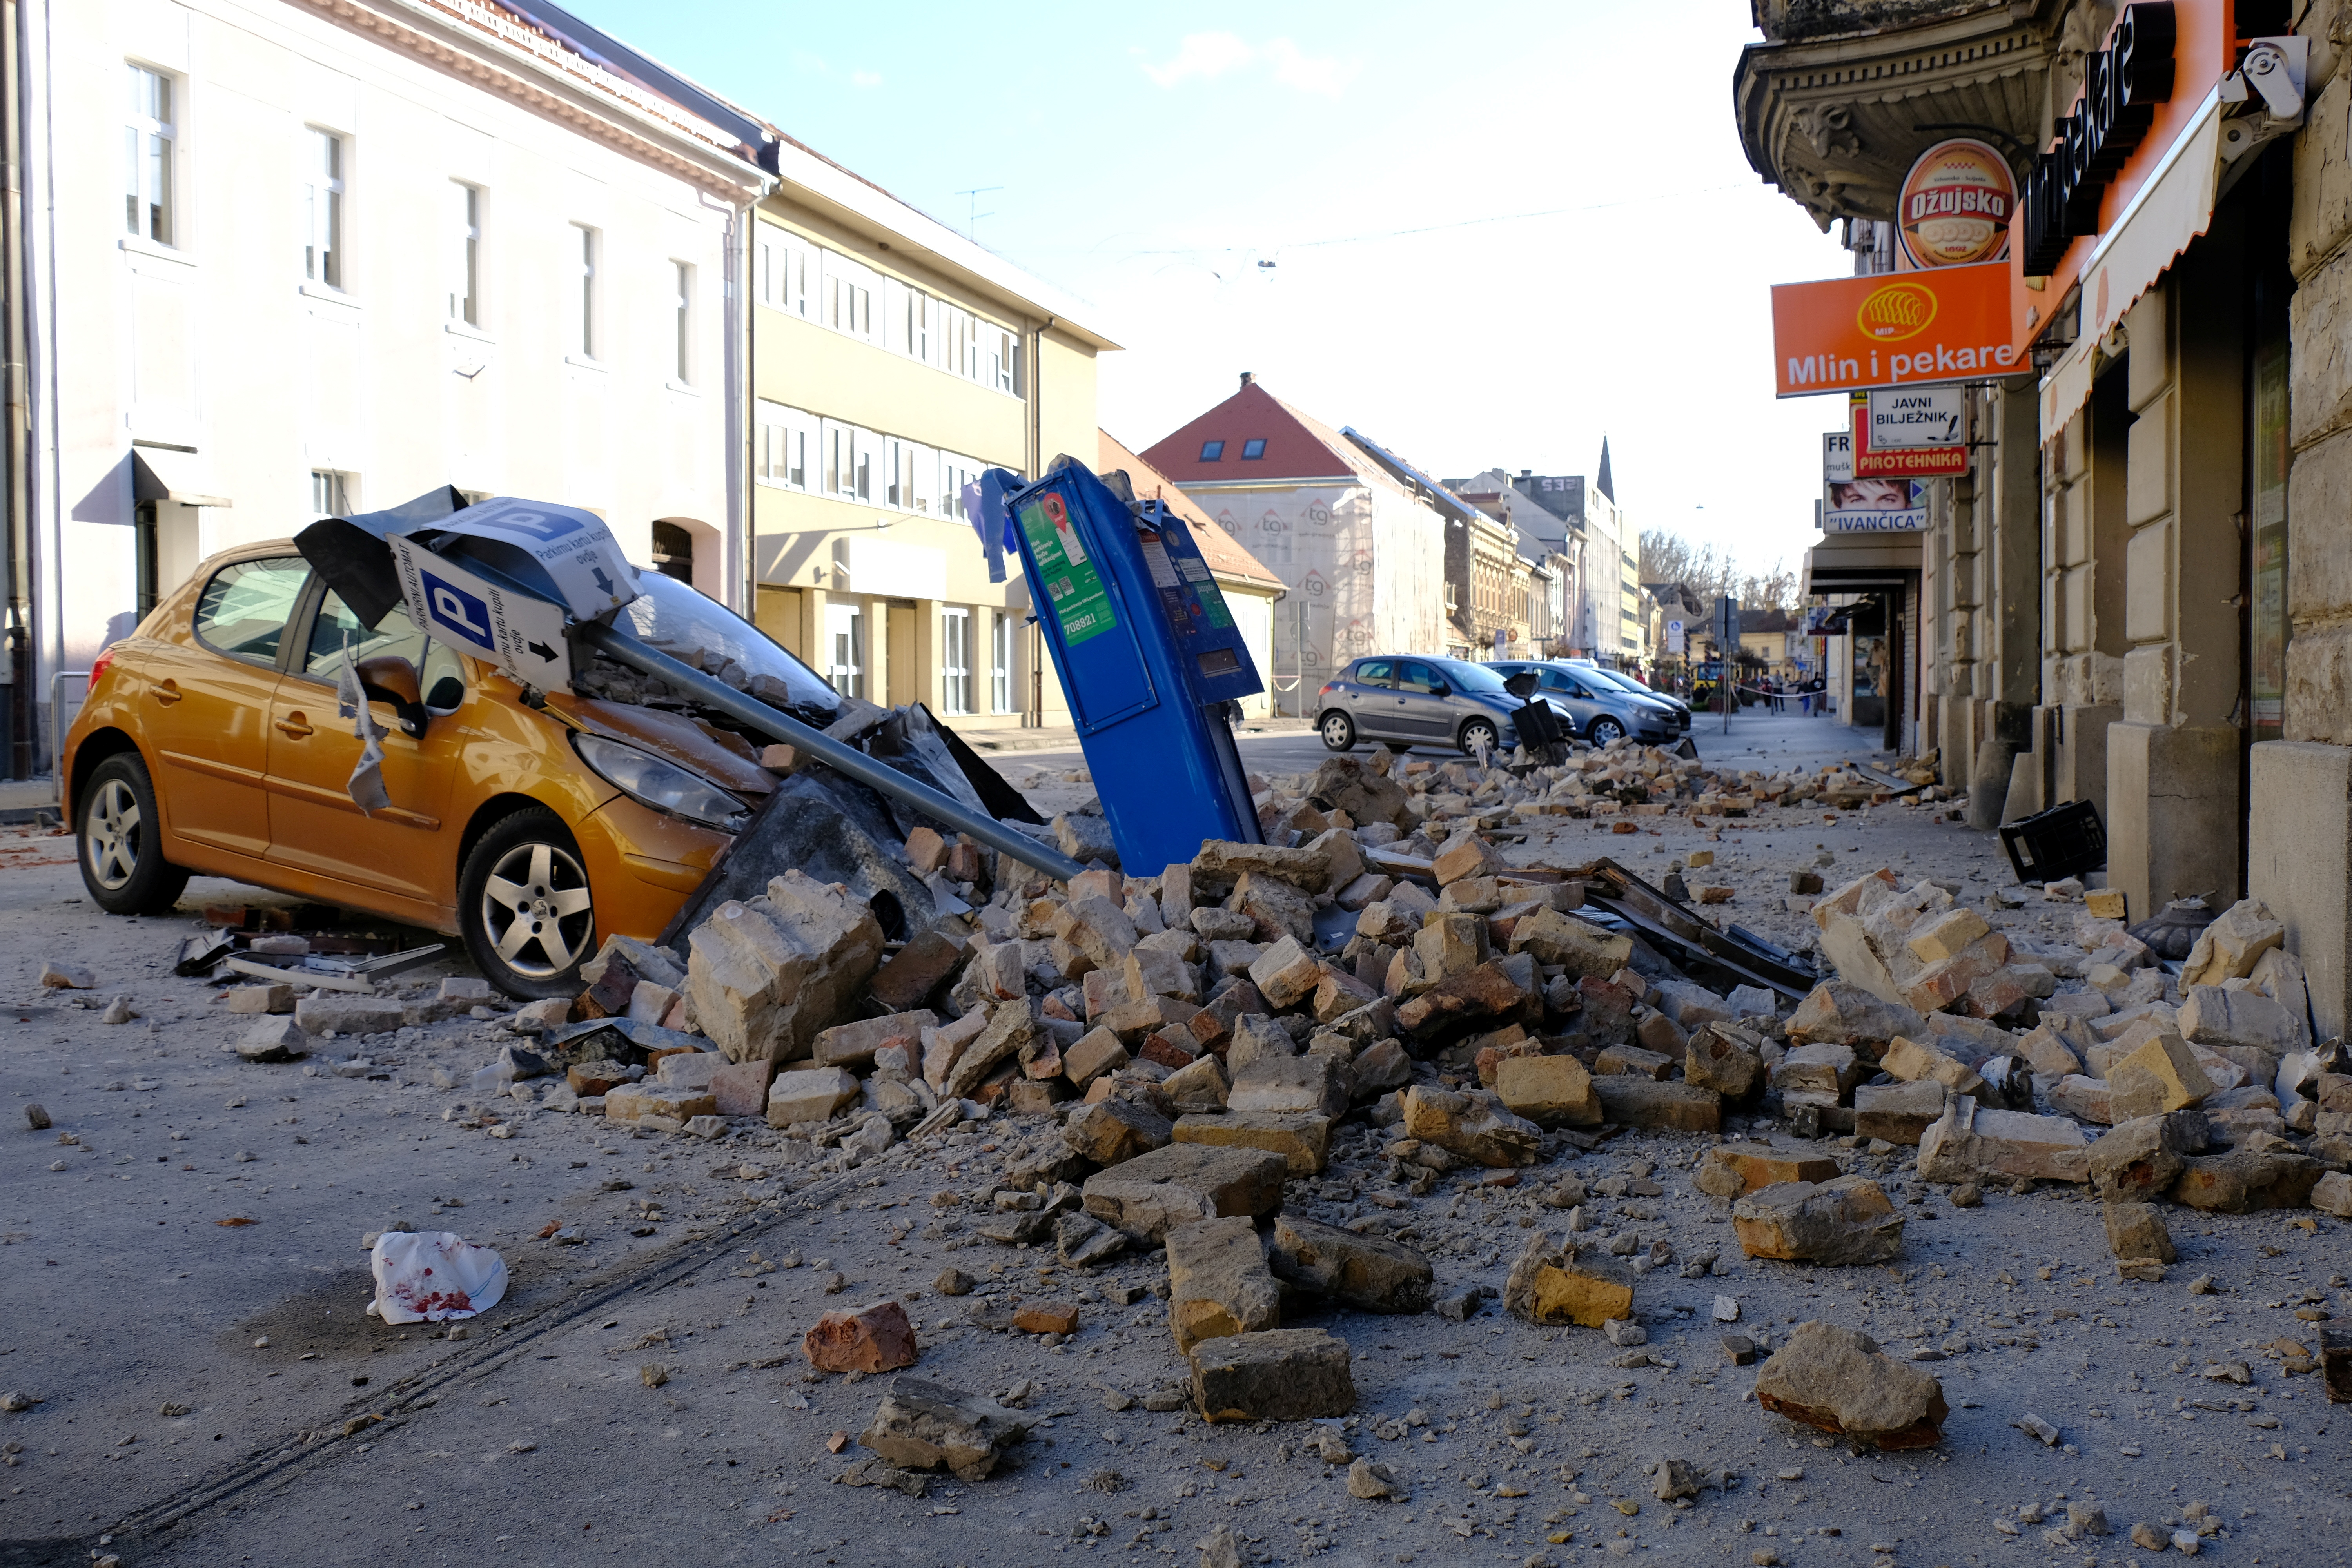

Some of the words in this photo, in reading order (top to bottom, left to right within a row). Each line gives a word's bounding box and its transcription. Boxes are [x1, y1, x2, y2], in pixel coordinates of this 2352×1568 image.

[1911, 187, 2004, 220] Ožujsko
[1875, 327, 1894, 336] MIP
[1788, 354, 1858, 385] Mlin
[1870, 350, 1878, 377] i
[1891, 343, 2012, 382] pekare
[1892, 397, 1931, 409] JAVNI
[1877, 410, 1948, 425] BILJEŽNIK
[1860, 452, 1962, 470] PIROTEHNIKA
[503, 512, 553, 534] P
[1263, 517, 1281, 536] tg
[1310, 507, 1328, 526] tg
[535, 543, 573, 561] Parkirnu
[567, 535, 592, 549] kartu
[576, 550, 598, 564] ovdje
[1033, 540, 1053, 554] parkiranje
[398, 543, 419, 590] AUTOMAT
[1197, 583, 1215, 595] paydo
[1306, 577, 1324, 596] tg
[410, 587, 430, 631] PARKIRNI
[434, 587, 486, 637] P
[487, 587, 505, 616] kupiti
[495, 617, 508, 641] kartu
[1064, 613, 1096, 635] 708821
[509, 629, 524, 654] ovdje
